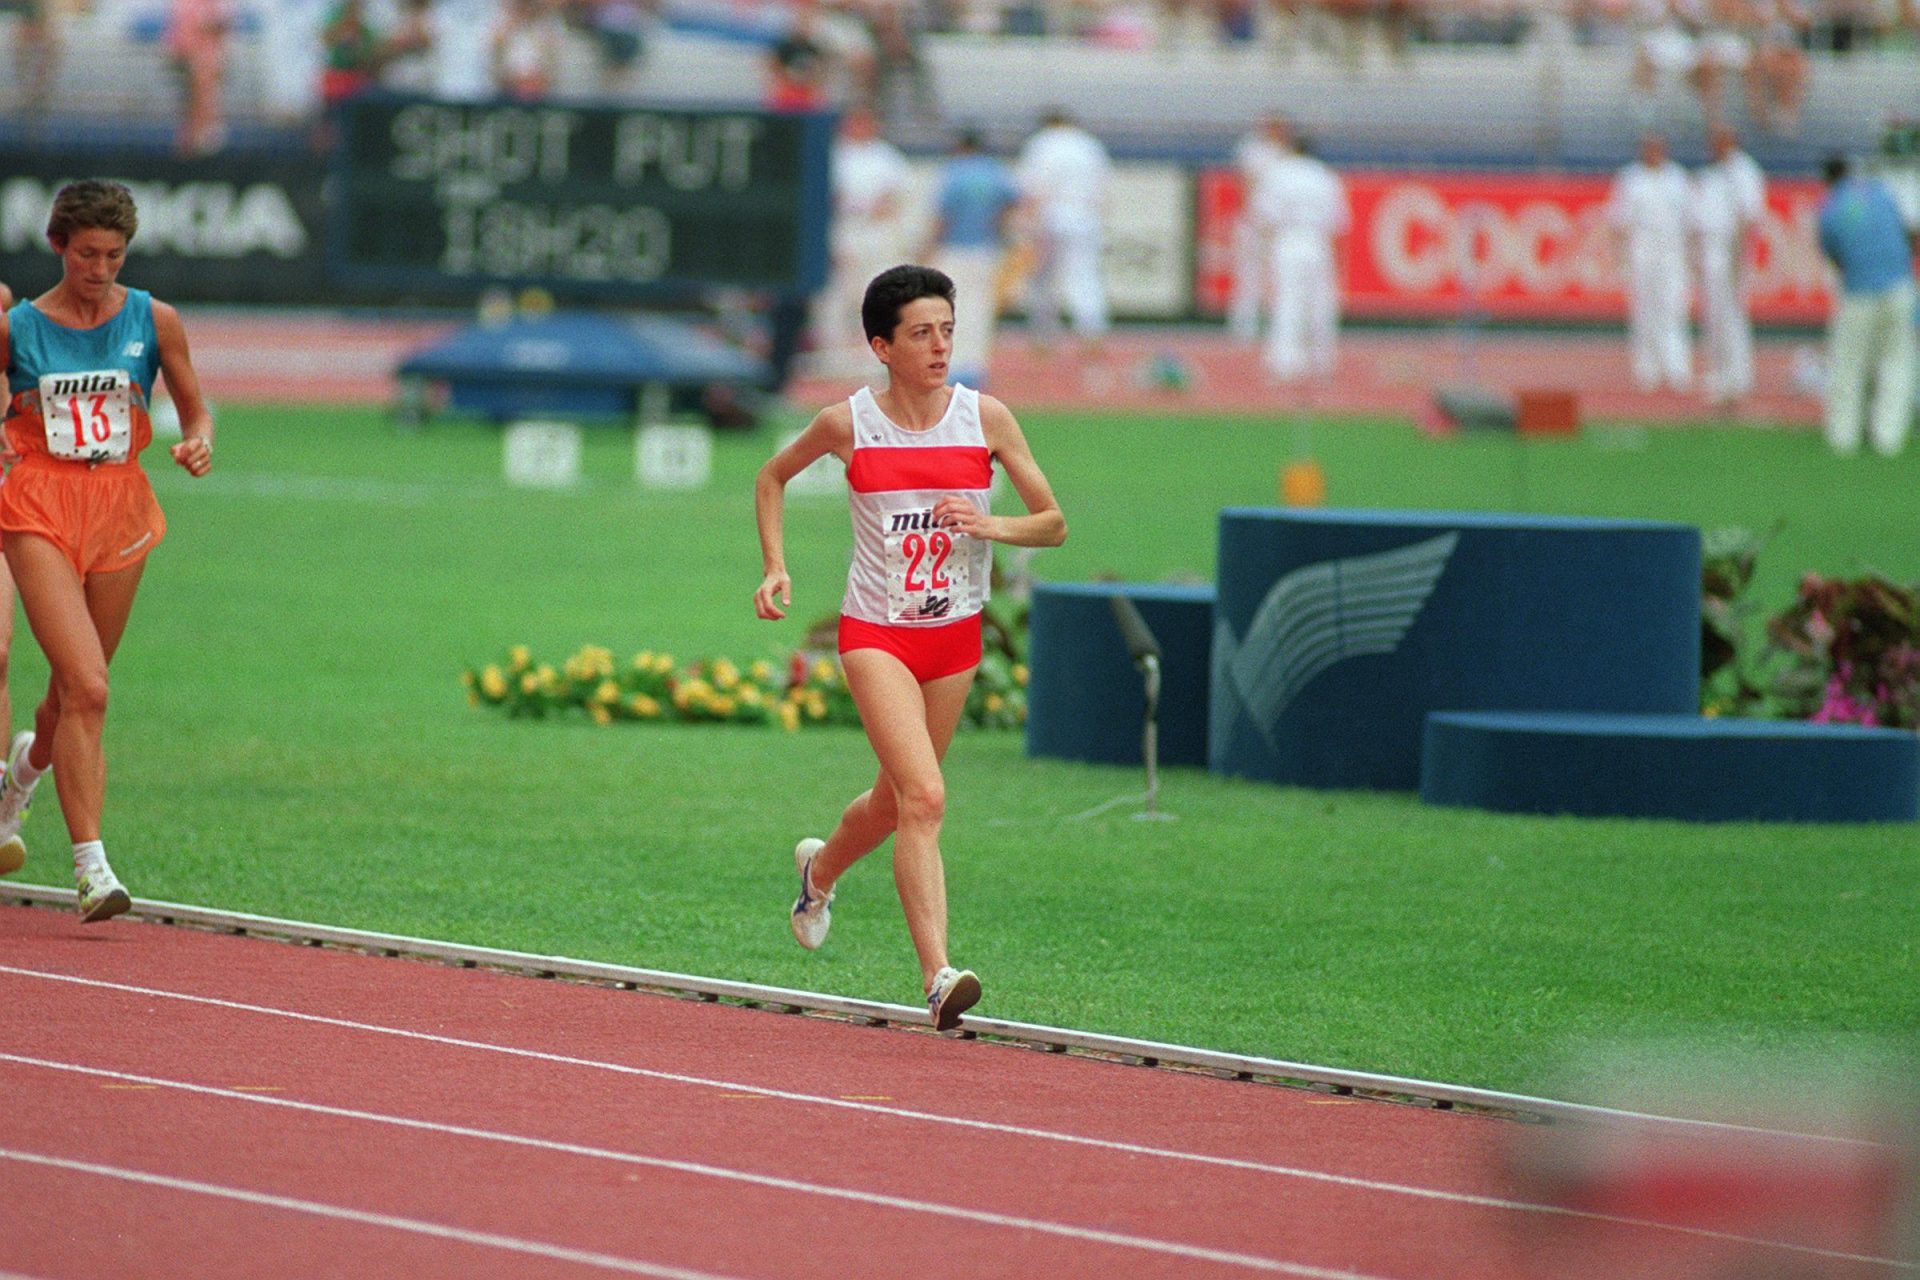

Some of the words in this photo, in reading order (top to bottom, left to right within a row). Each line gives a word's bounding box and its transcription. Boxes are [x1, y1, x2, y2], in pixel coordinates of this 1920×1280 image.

[390, 105, 579, 185] SHOT
[613, 112, 765, 193] PUT
[54, 375, 116, 395] mita
[67, 393, 112, 448] 13
[891, 508, 959, 532] mi
[902, 531, 952, 593] 22
